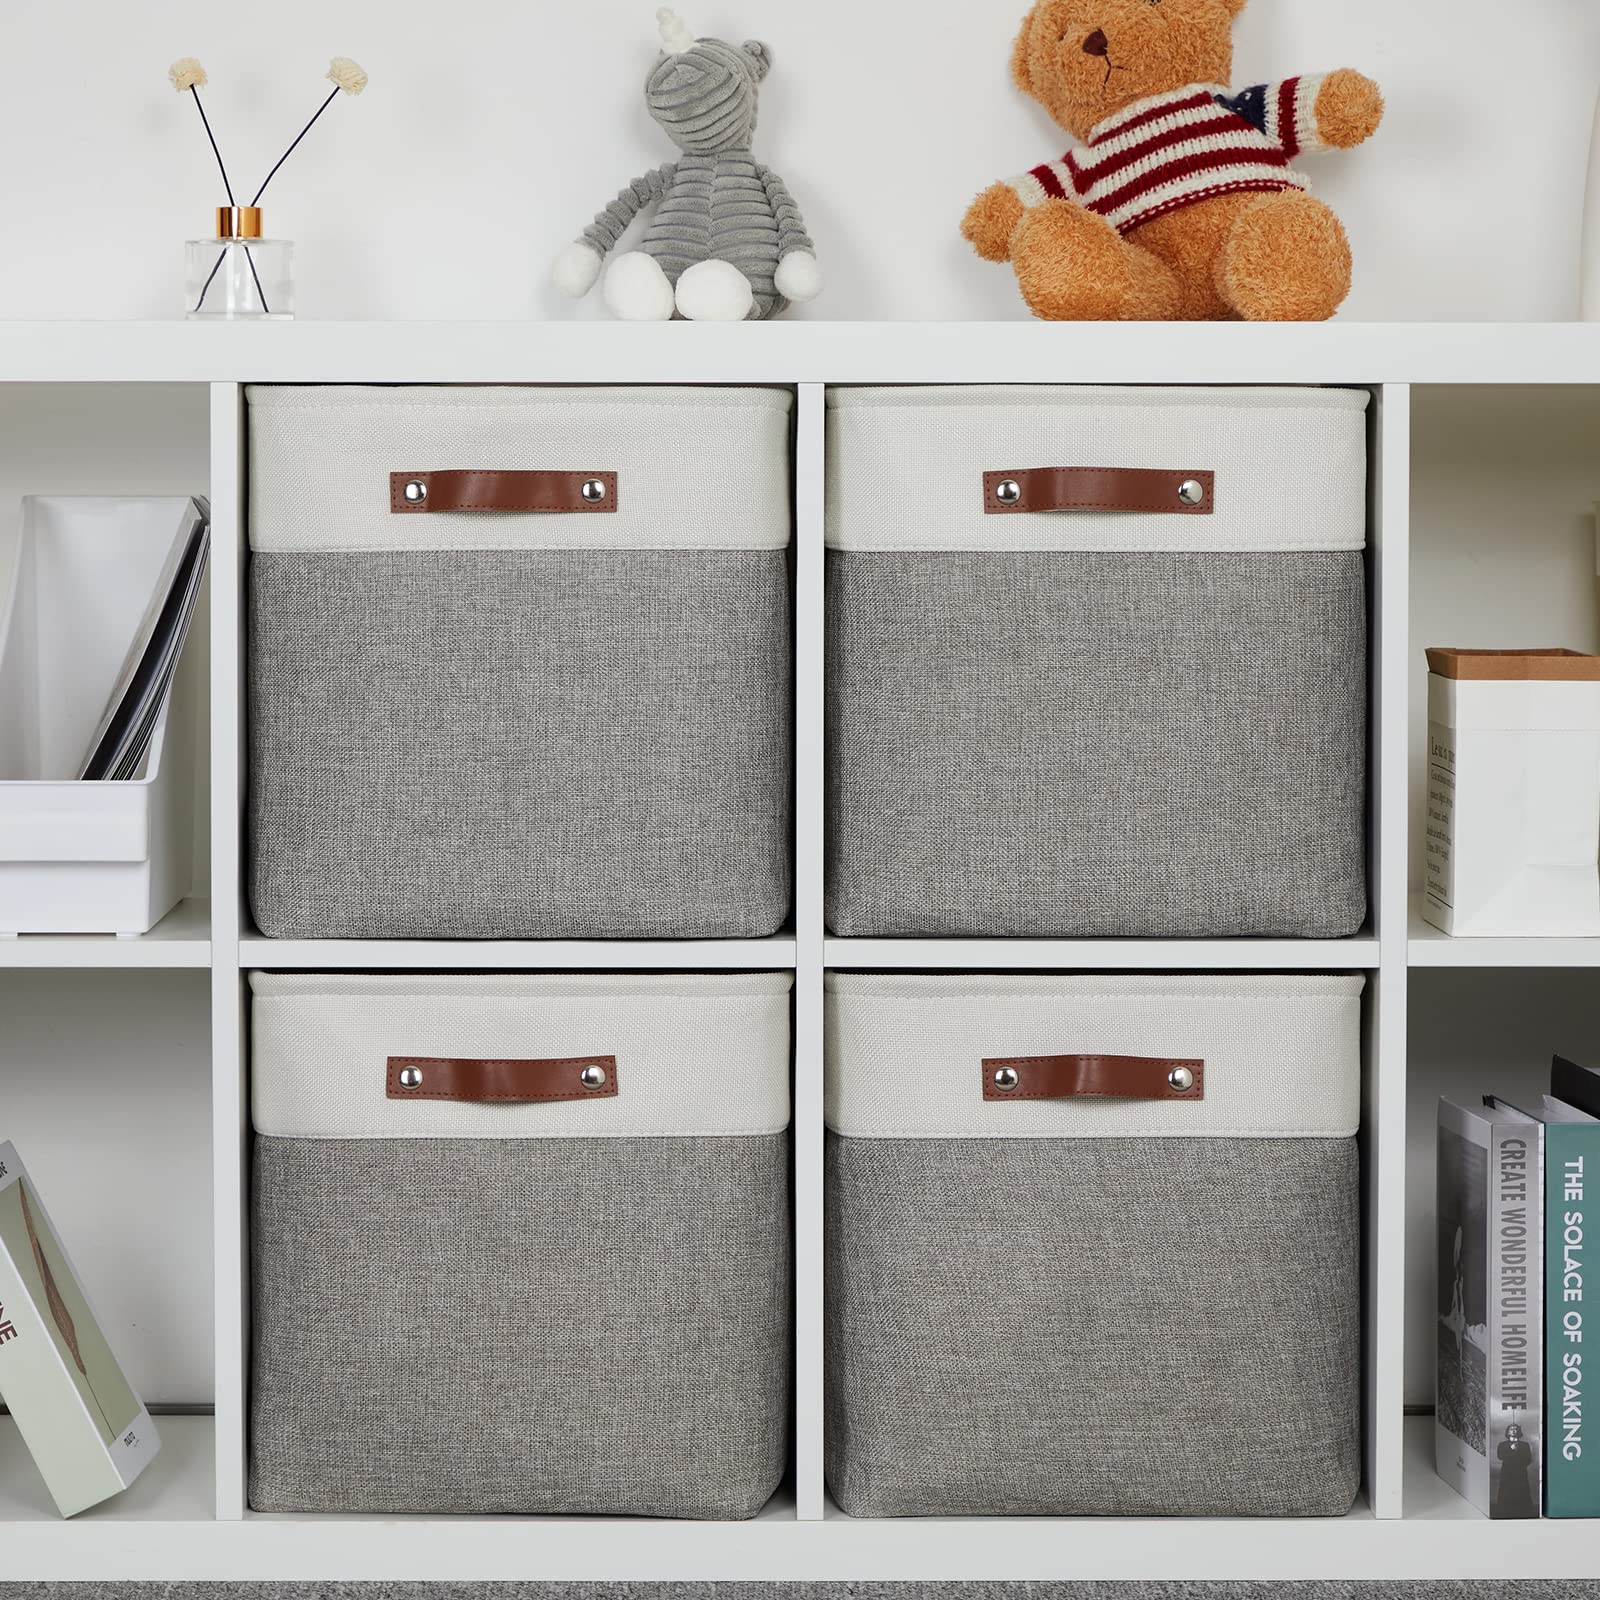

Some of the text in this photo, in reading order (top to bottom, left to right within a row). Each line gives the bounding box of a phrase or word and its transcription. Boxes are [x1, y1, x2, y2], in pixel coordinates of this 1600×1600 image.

[1500, 1139, 1527, 1410] CREATE WONDERFUL HOMELIFE
[1562, 1156, 1584, 1461] THE SOLACE OF SOAKING
